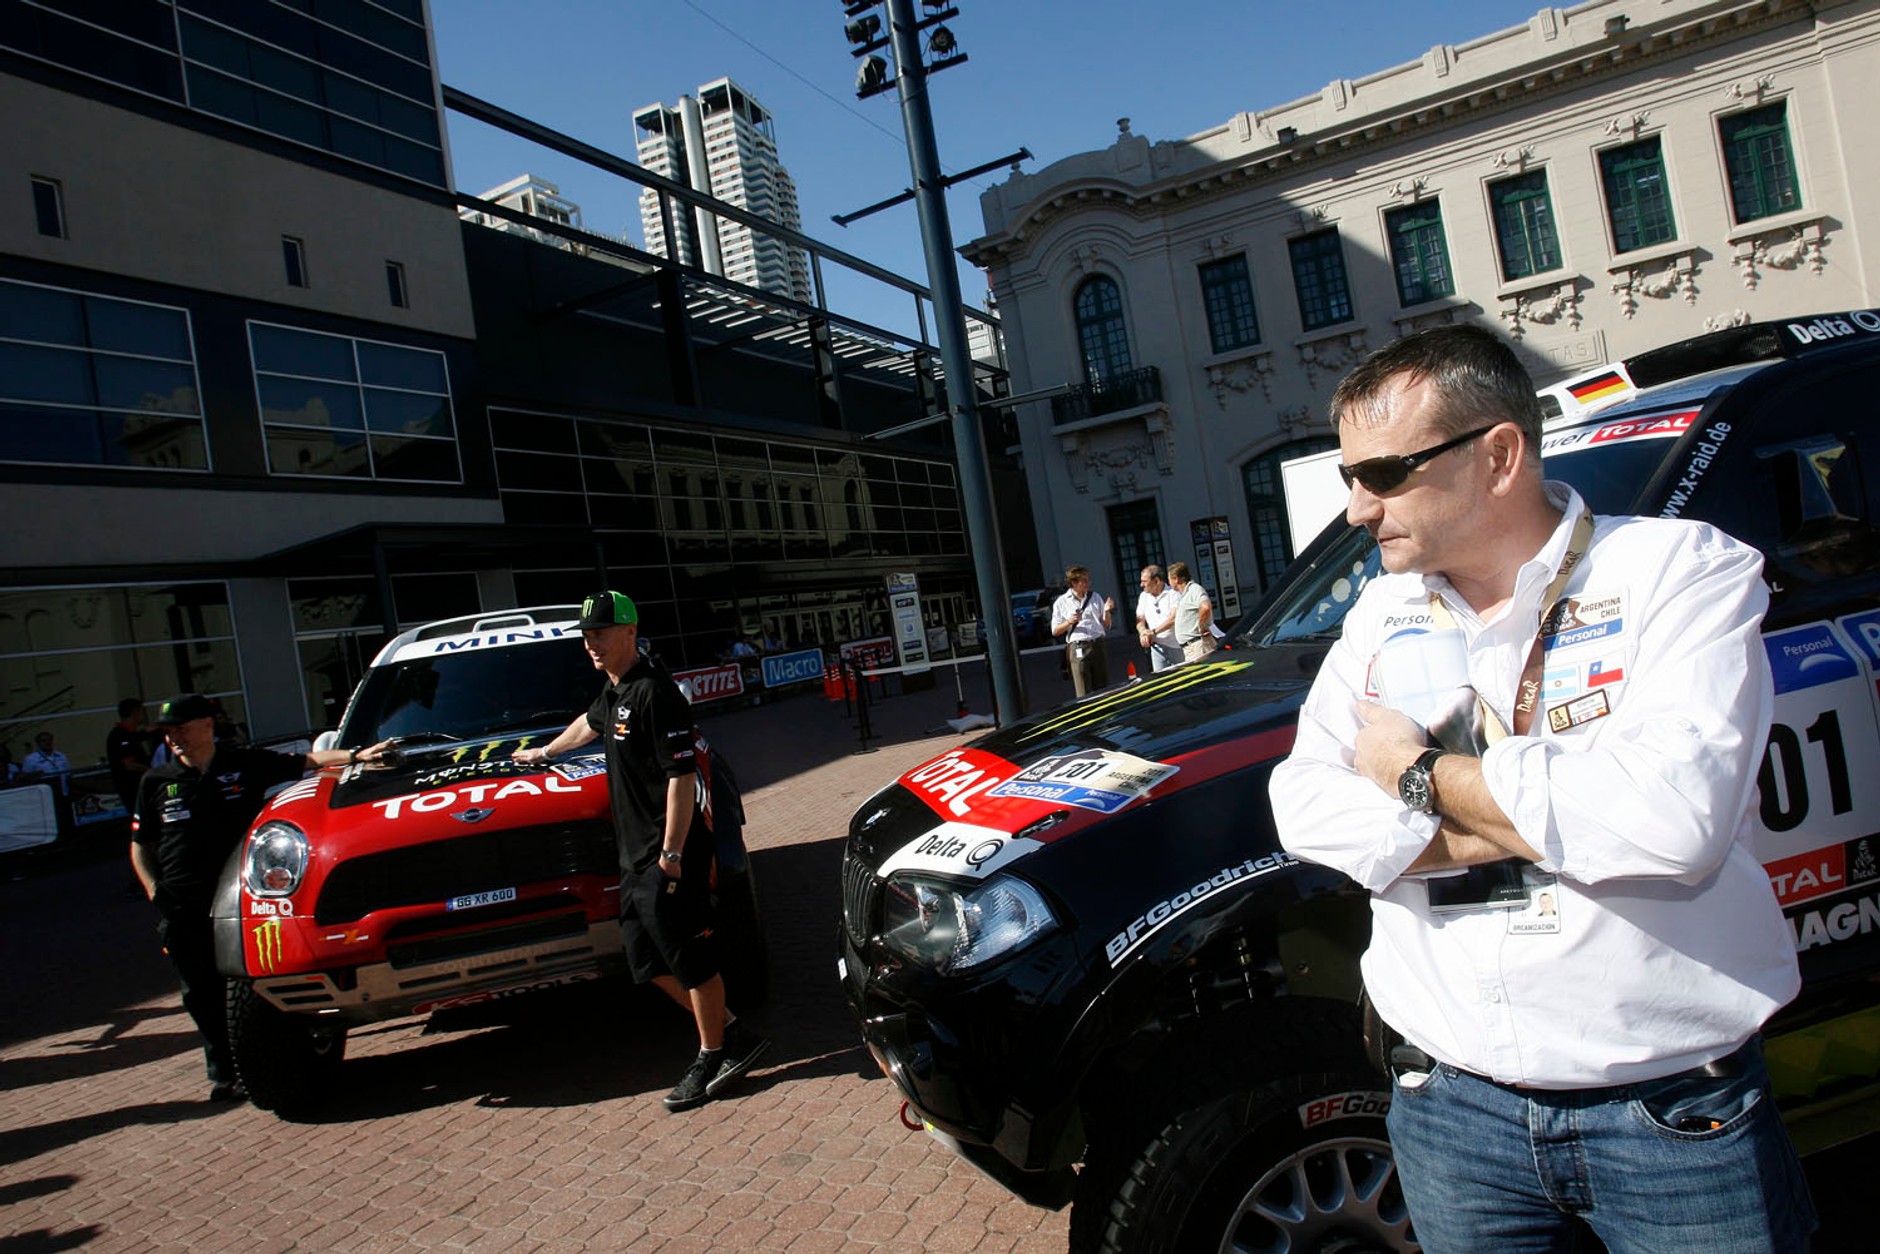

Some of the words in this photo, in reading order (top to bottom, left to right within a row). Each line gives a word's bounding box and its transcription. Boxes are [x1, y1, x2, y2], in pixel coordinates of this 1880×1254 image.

[1787, 319, 1855, 344] Delta
[1599, 417, 1691, 438] TOTAL
[1580, 596, 1622, 614] ARGENTINA
[1600, 606, 1621, 619] CHILE
[1558, 623, 1608, 646] Personal
[1782, 635, 1834, 656] Personal
[768, 656, 818, 681] Macro
[907, 751, 1001, 817] TOTAL
[997, 782, 1075, 799] Personal
[372, 776, 582, 819] TOTAL
[914, 834, 967, 859] Delta
[474, 893, 490, 905] XR
[492, 889, 514, 901] 600
[1105, 851, 1300, 962] BFGoodrich
[251, 902, 277, 915] Delta
